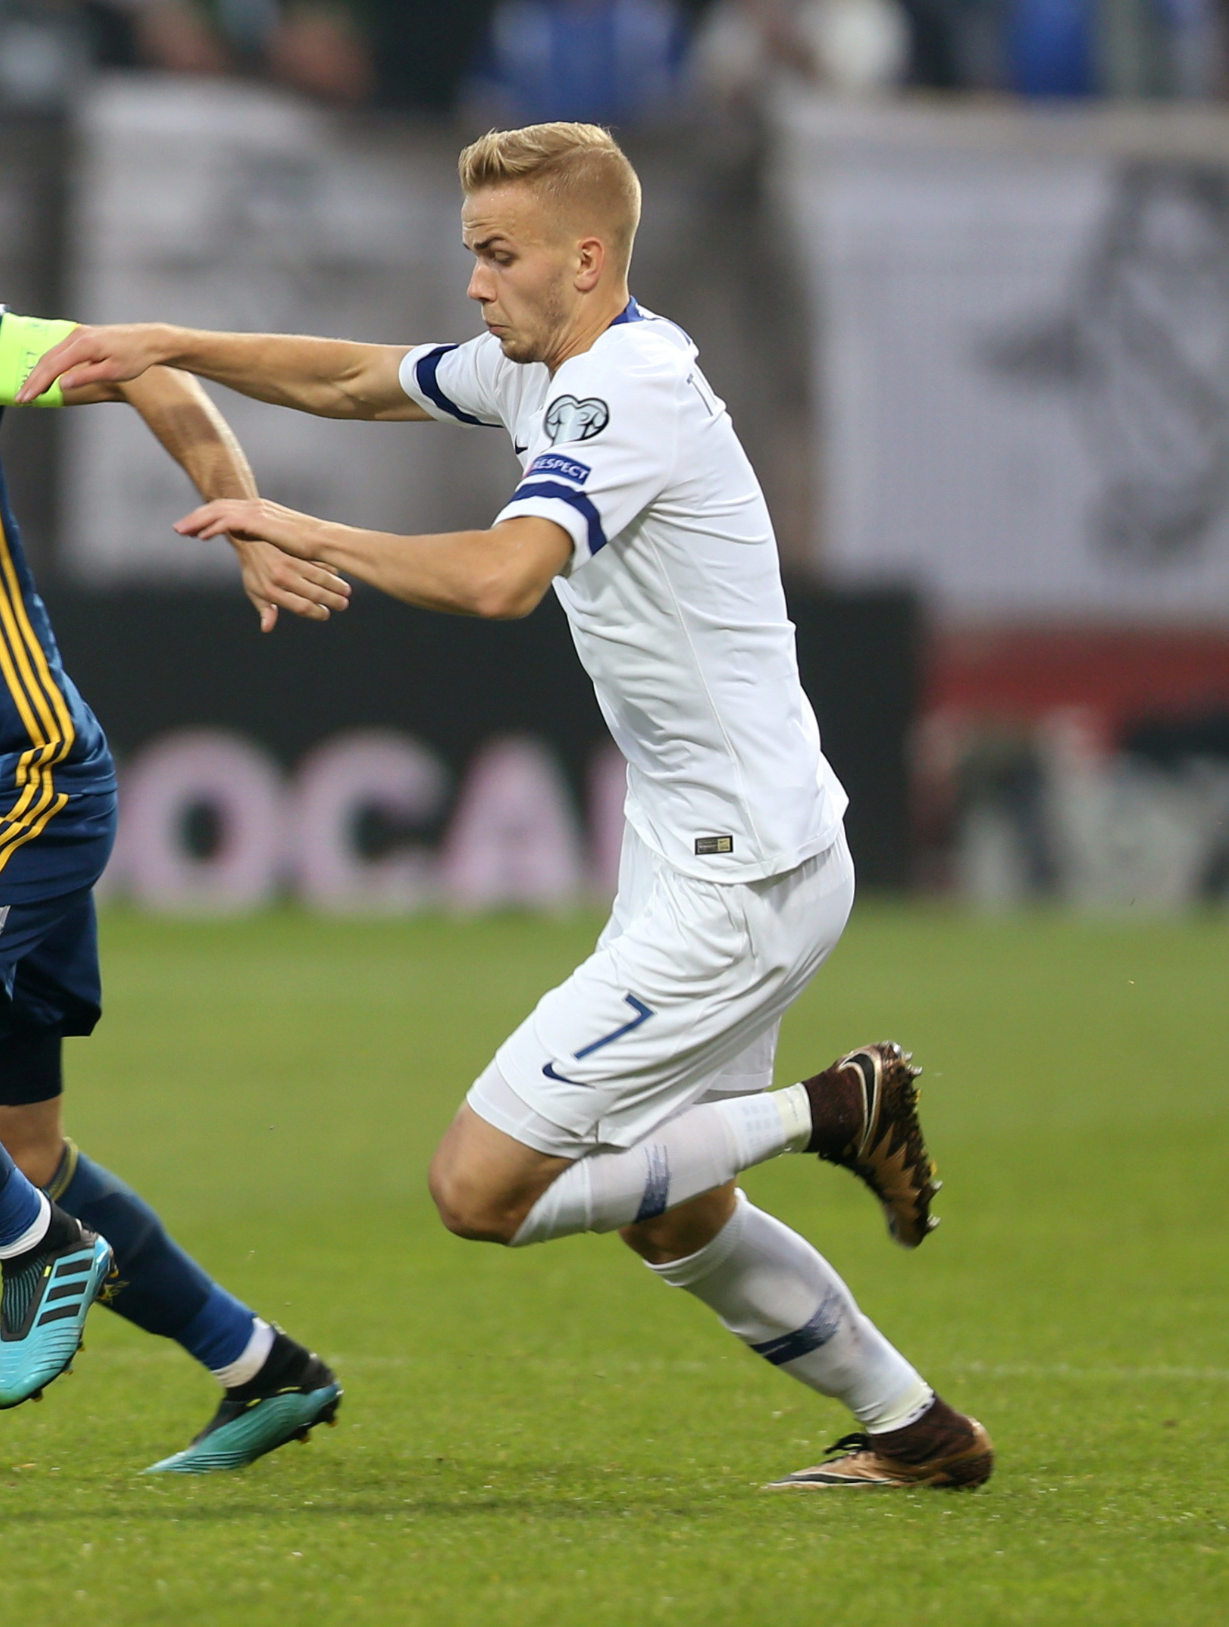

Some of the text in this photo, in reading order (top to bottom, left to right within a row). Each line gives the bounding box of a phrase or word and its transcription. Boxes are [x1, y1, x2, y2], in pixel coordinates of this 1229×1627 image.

[533, 457, 589, 480] RESPECT
[100, 725, 630, 914] OCA
[572, 993, 654, 1060] 7
